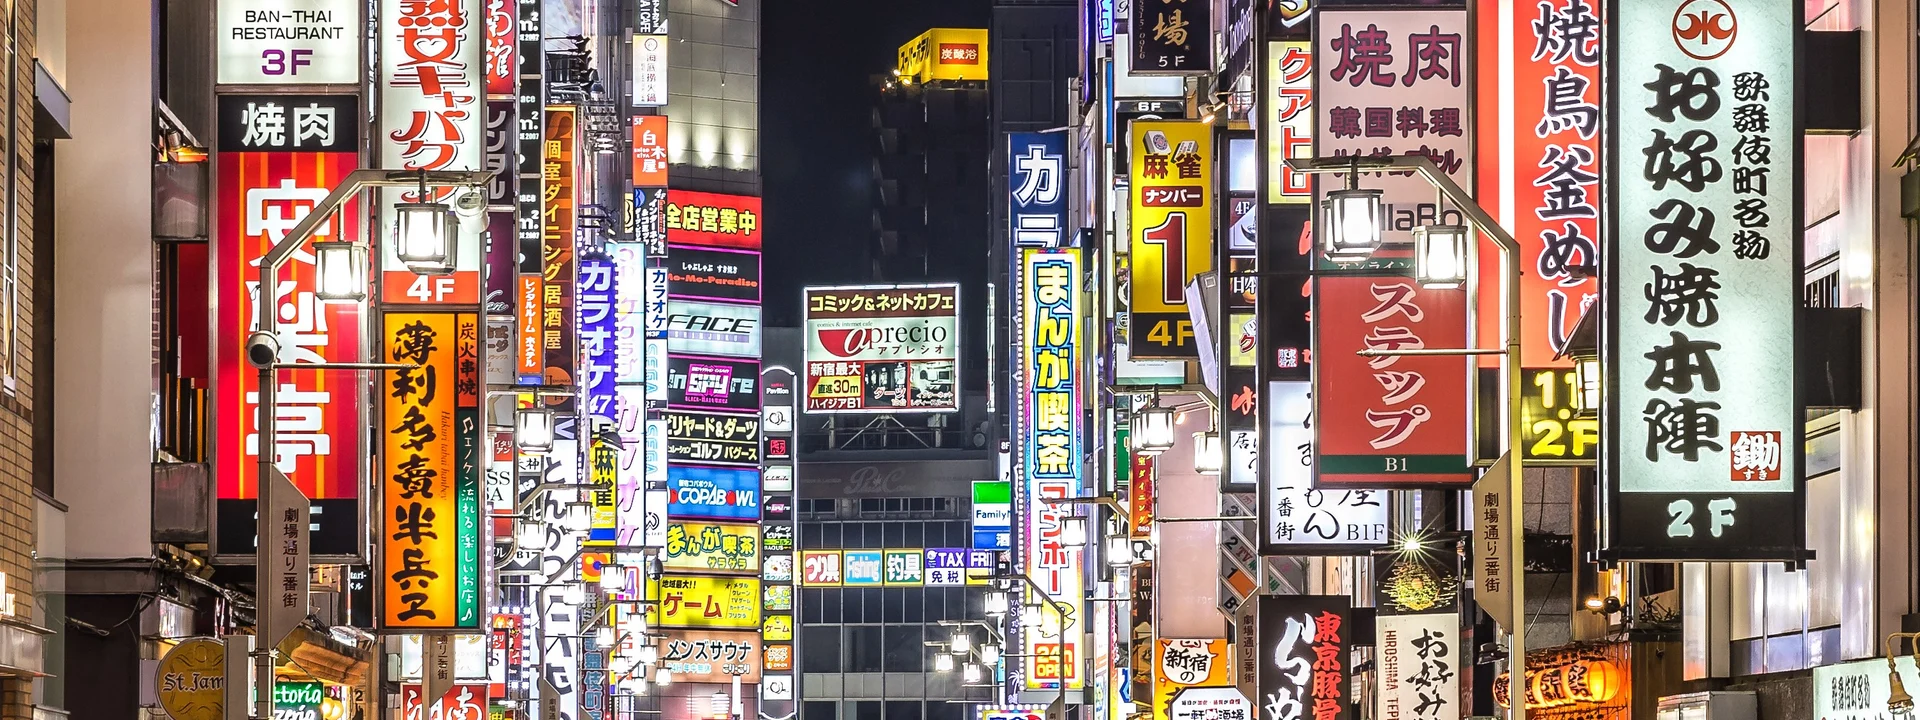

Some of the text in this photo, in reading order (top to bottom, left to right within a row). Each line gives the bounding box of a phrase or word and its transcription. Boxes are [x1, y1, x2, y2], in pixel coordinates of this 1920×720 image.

[245, 10, 331, 23] BAN-THAI
[1152, 0, 1190, 46] 場
[232, 27, 344, 40] RESTAURANT
[261, 49, 313, 75] 3F
[941, 48, 977, 60] 炭酸浴
[1330, 24, 1462, 87] 焼肉
[388, 0, 474, 203] 熟女キャバク
[1138, 102, 1161, 112] 6F
[241, 102, 336, 147] 焼肉
[634, 117, 643, 125] 5F
[1280, 48, 1312, 195] クアトロ
[1329, 106, 1463, 139] 韓国料理
[1143, 153, 1202, 179] 麻雀
[1531, 0, 1599, 352] 焼鳥釜めし
[1732, 72, 1771, 260] 歌舞伎町名物
[1146, 189, 1200, 203] ナンバー
[667, 203, 756, 235] 全店営業中
[545, 140, 562, 350] 個室ダイニング居酒屋
[1143, 211, 1187, 305] 1
[1643, 63, 1724, 462] お好み焼本陣
[406, 275, 455, 301] 4F
[652, 270, 666, 329] カラオケ
[811, 292, 954, 312] コミック&ネットカフェ
[525, 279, 536, 367] レンタルルーム ホステル
[581, 261, 612, 389] カラオケ
[668, 314, 757, 333] FACE
[1147, 320, 1195, 347] 4F
[878, 345, 944, 355] アプレシオ
[811, 362, 861, 376] 新宿最大
[1034, 260, 1073, 476] まんが喫茶
[1360, 282, 1431, 450] ステップ
[818, 379, 859, 394] 直進30m
[811, 398, 861, 409] ハイジアB1
[690, 442, 757, 460] ゴルフ バグース
[1385, 457, 1408, 471] B1
[1732, 432, 1780, 471] 鋤
[1743, 469, 1768, 481] すき
[1275, 486, 1296, 541] 一番街
[1667, 498, 1737, 538] 2F
[668, 525, 755, 556] まんが喫茶
[1346, 523, 1384, 541] B1F
[1484, 492, 1500, 593] 劇場通り一番街
[283, 507, 299, 607] 劇場通り一番街
[707, 556, 748, 569] ゲラゲラ
[805, 555, 839, 582] つり具
[887, 555, 921, 581] 釣具
[939, 554, 965, 568] TAX
[932, 571, 959, 583] 免税
[664, 592, 723, 618] ゲーム
[765, 625, 790, 633] ゲーム
[666, 640, 752, 662] メンズサウナ
[1165, 648, 1209, 672] 新宿
[1243, 614, 1255, 683] 劇場通り一番街
[1384, 631, 1399, 690] HIROSHIMA
[1180, 671, 1195, 682] の
[1311, 611, 1342, 720] 東京豚骨
